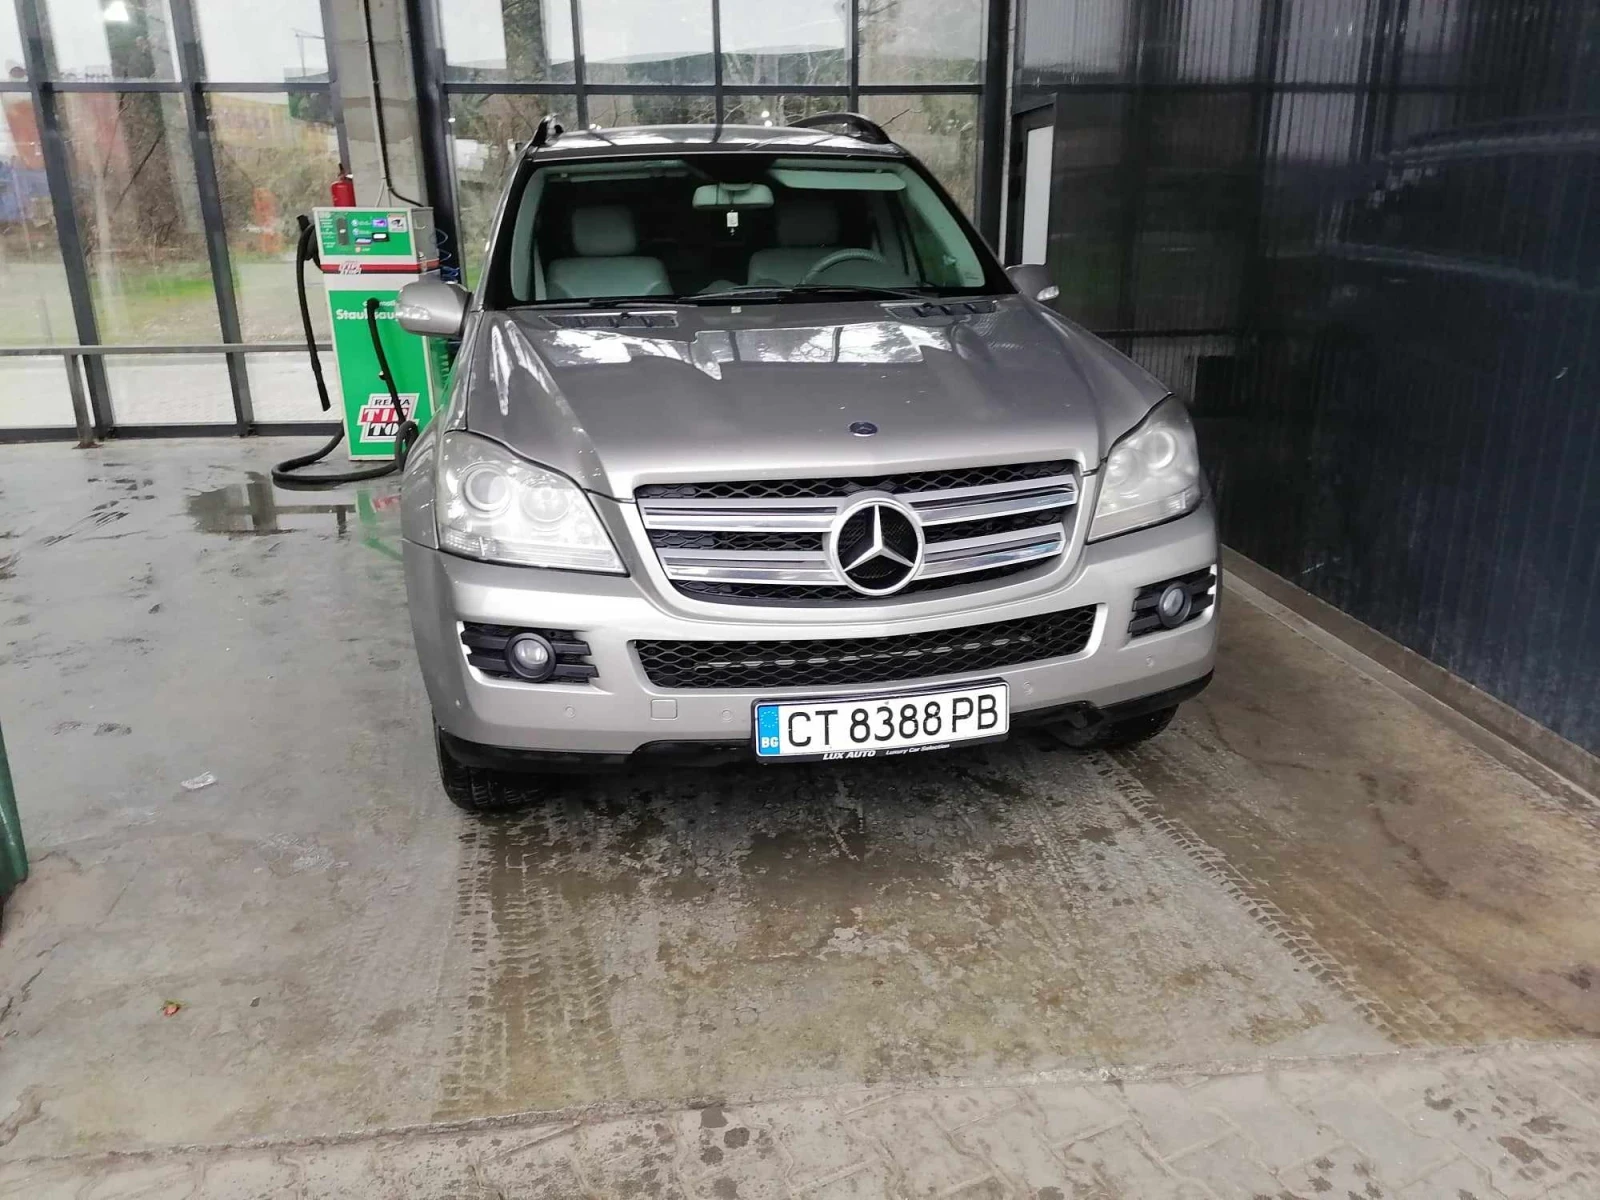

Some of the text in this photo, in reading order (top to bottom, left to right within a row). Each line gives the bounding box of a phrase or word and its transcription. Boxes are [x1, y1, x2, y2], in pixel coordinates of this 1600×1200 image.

[370, 423, 400, 436] TO
[787, 693, 999, 748] CT 8388 PB
[761, 736, 779, 748] BG
[822, 749, 876, 761] LUX AUTO
[885, 747, 908, 756] Luxury
